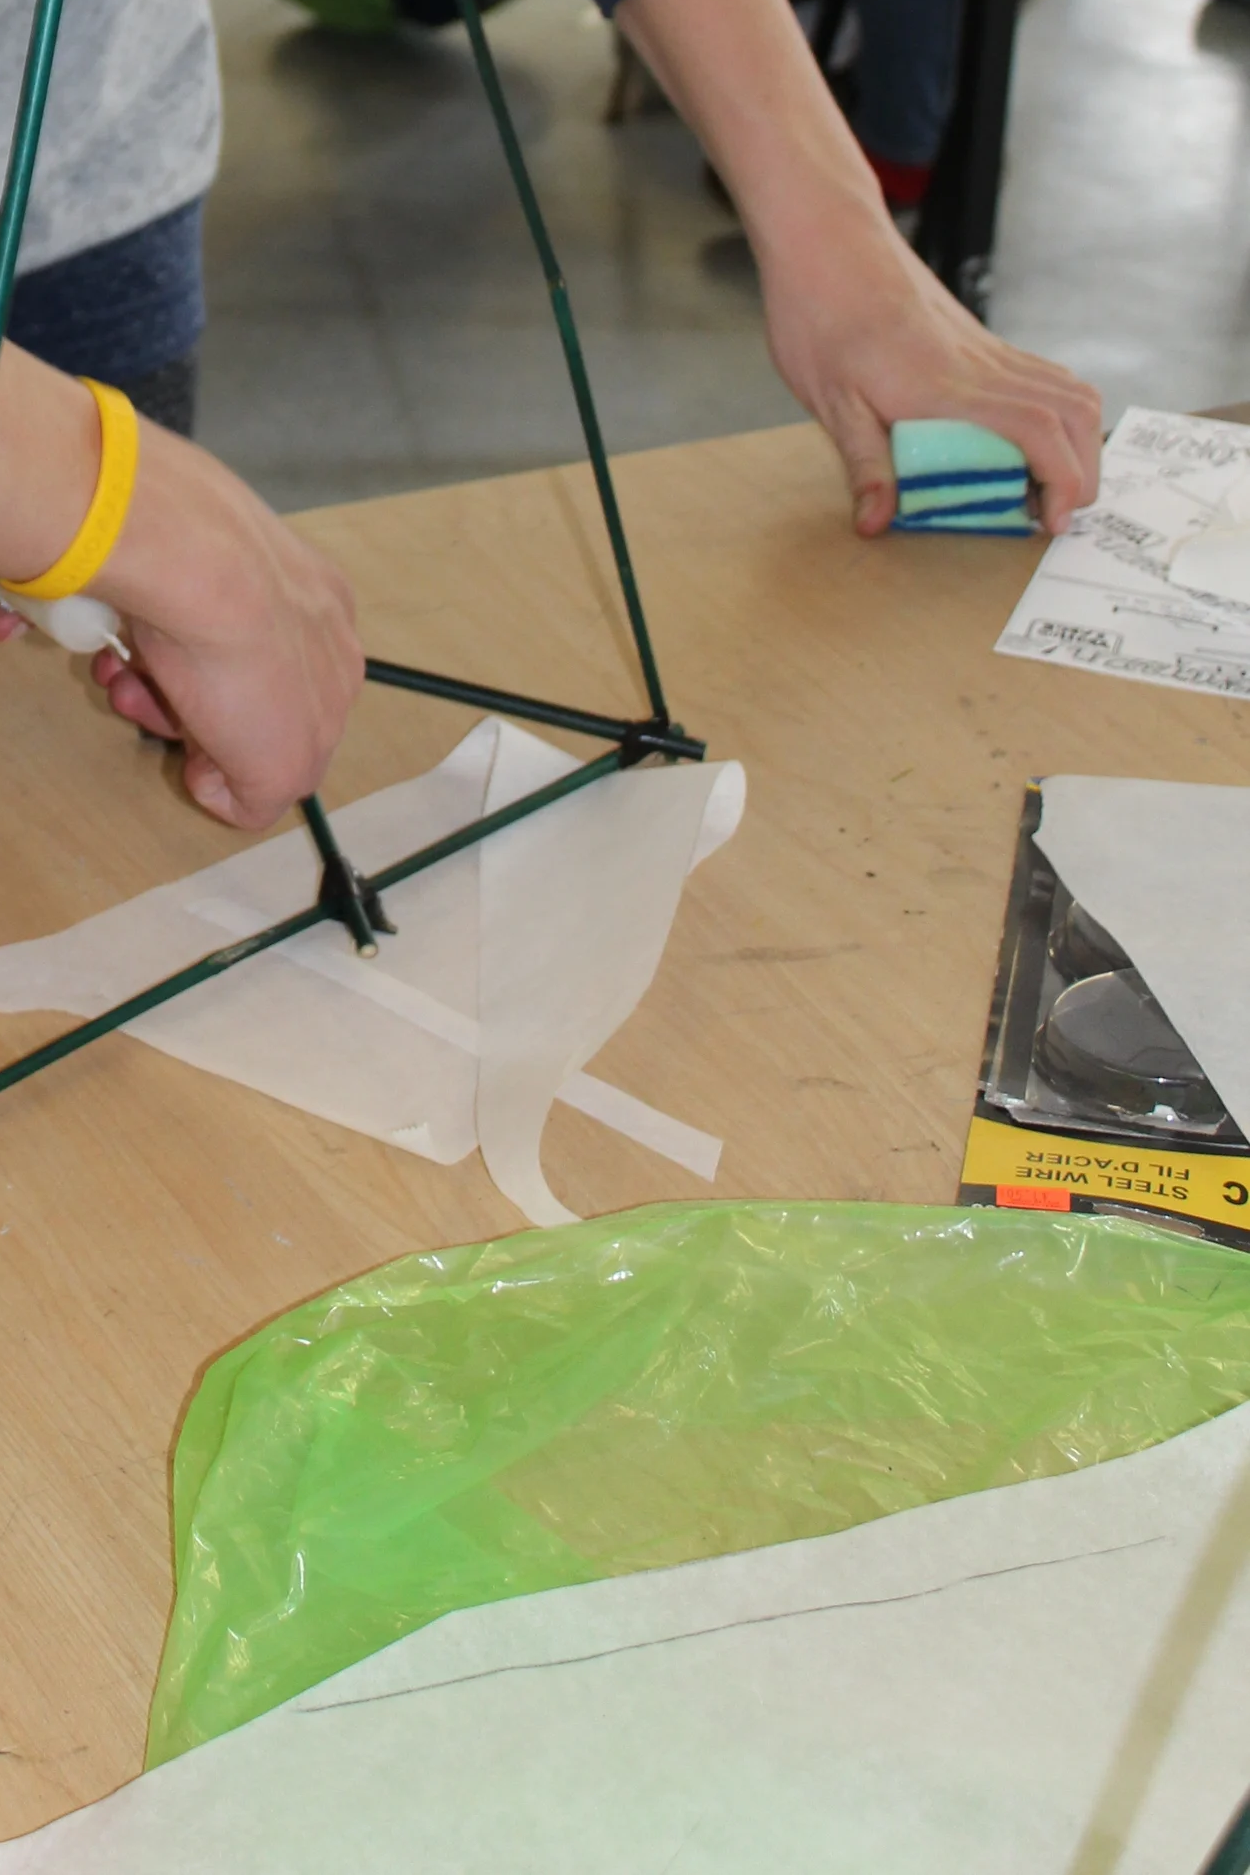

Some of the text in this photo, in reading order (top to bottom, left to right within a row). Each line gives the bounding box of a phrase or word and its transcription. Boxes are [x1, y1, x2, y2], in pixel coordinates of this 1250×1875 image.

[1025, 1151, 1190, 1181] FIL D'ACIER
[1015, 1166, 1189, 1200] STEEL WIRE
